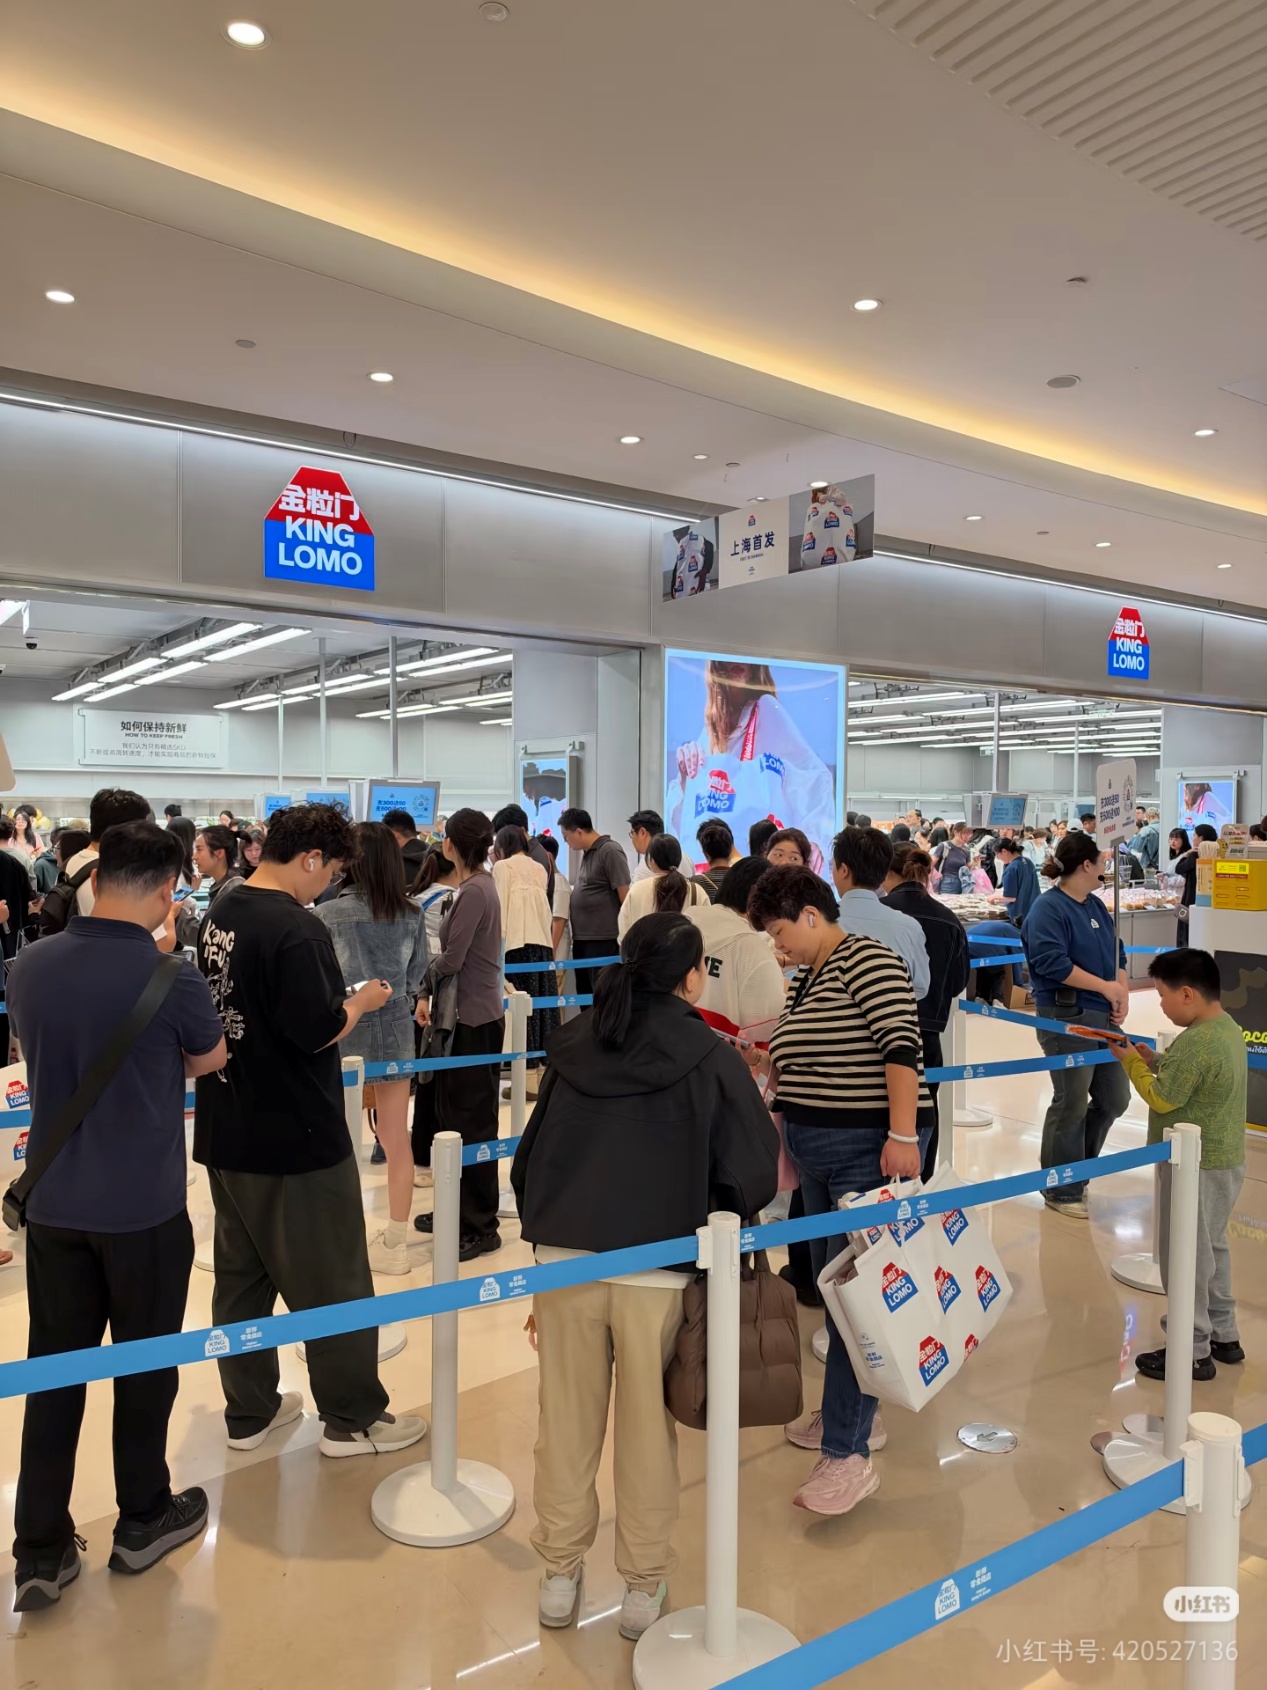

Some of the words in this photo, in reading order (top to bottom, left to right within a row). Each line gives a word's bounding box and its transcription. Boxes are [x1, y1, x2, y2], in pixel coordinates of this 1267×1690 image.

[278, 484, 360, 521] 金粒门
[285, 515, 355, 548] KING
[730, 530, 775, 557] 上海首发
[278, 542, 363, 576] LOMO
[1114, 617, 1145, 638] 金粒门
[1116, 636, 1143, 654] KING
[1113, 652, 1145, 671] LOMO
[120, 720, 187, 733] 如何保持新鲜
[10, 1090, 27, 1099] KING
[10, 1096, 30, 1106] LOMO
[17, 1150, 27, 1158] LO
[945, 1211, 960, 1230] KING
[948, 1218, 965, 1240] LOMO
[885, 1276, 906, 1296] KING
[888, 1283, 913, 1307] LOMO
[981, 1277, 994, 1297] KING
[983, 1284, 998, 1307] LOMO
[942, 1285, 957, 1308] LOMO
[207, 1345, 227, 1354] LOMO
[924, 1349, 942, 1370] KING
[925, 1356, 946, 1380] LOMO
[937, 1599, 957, 1615] LOMO
[939, 1591, 956, 1605] KING
